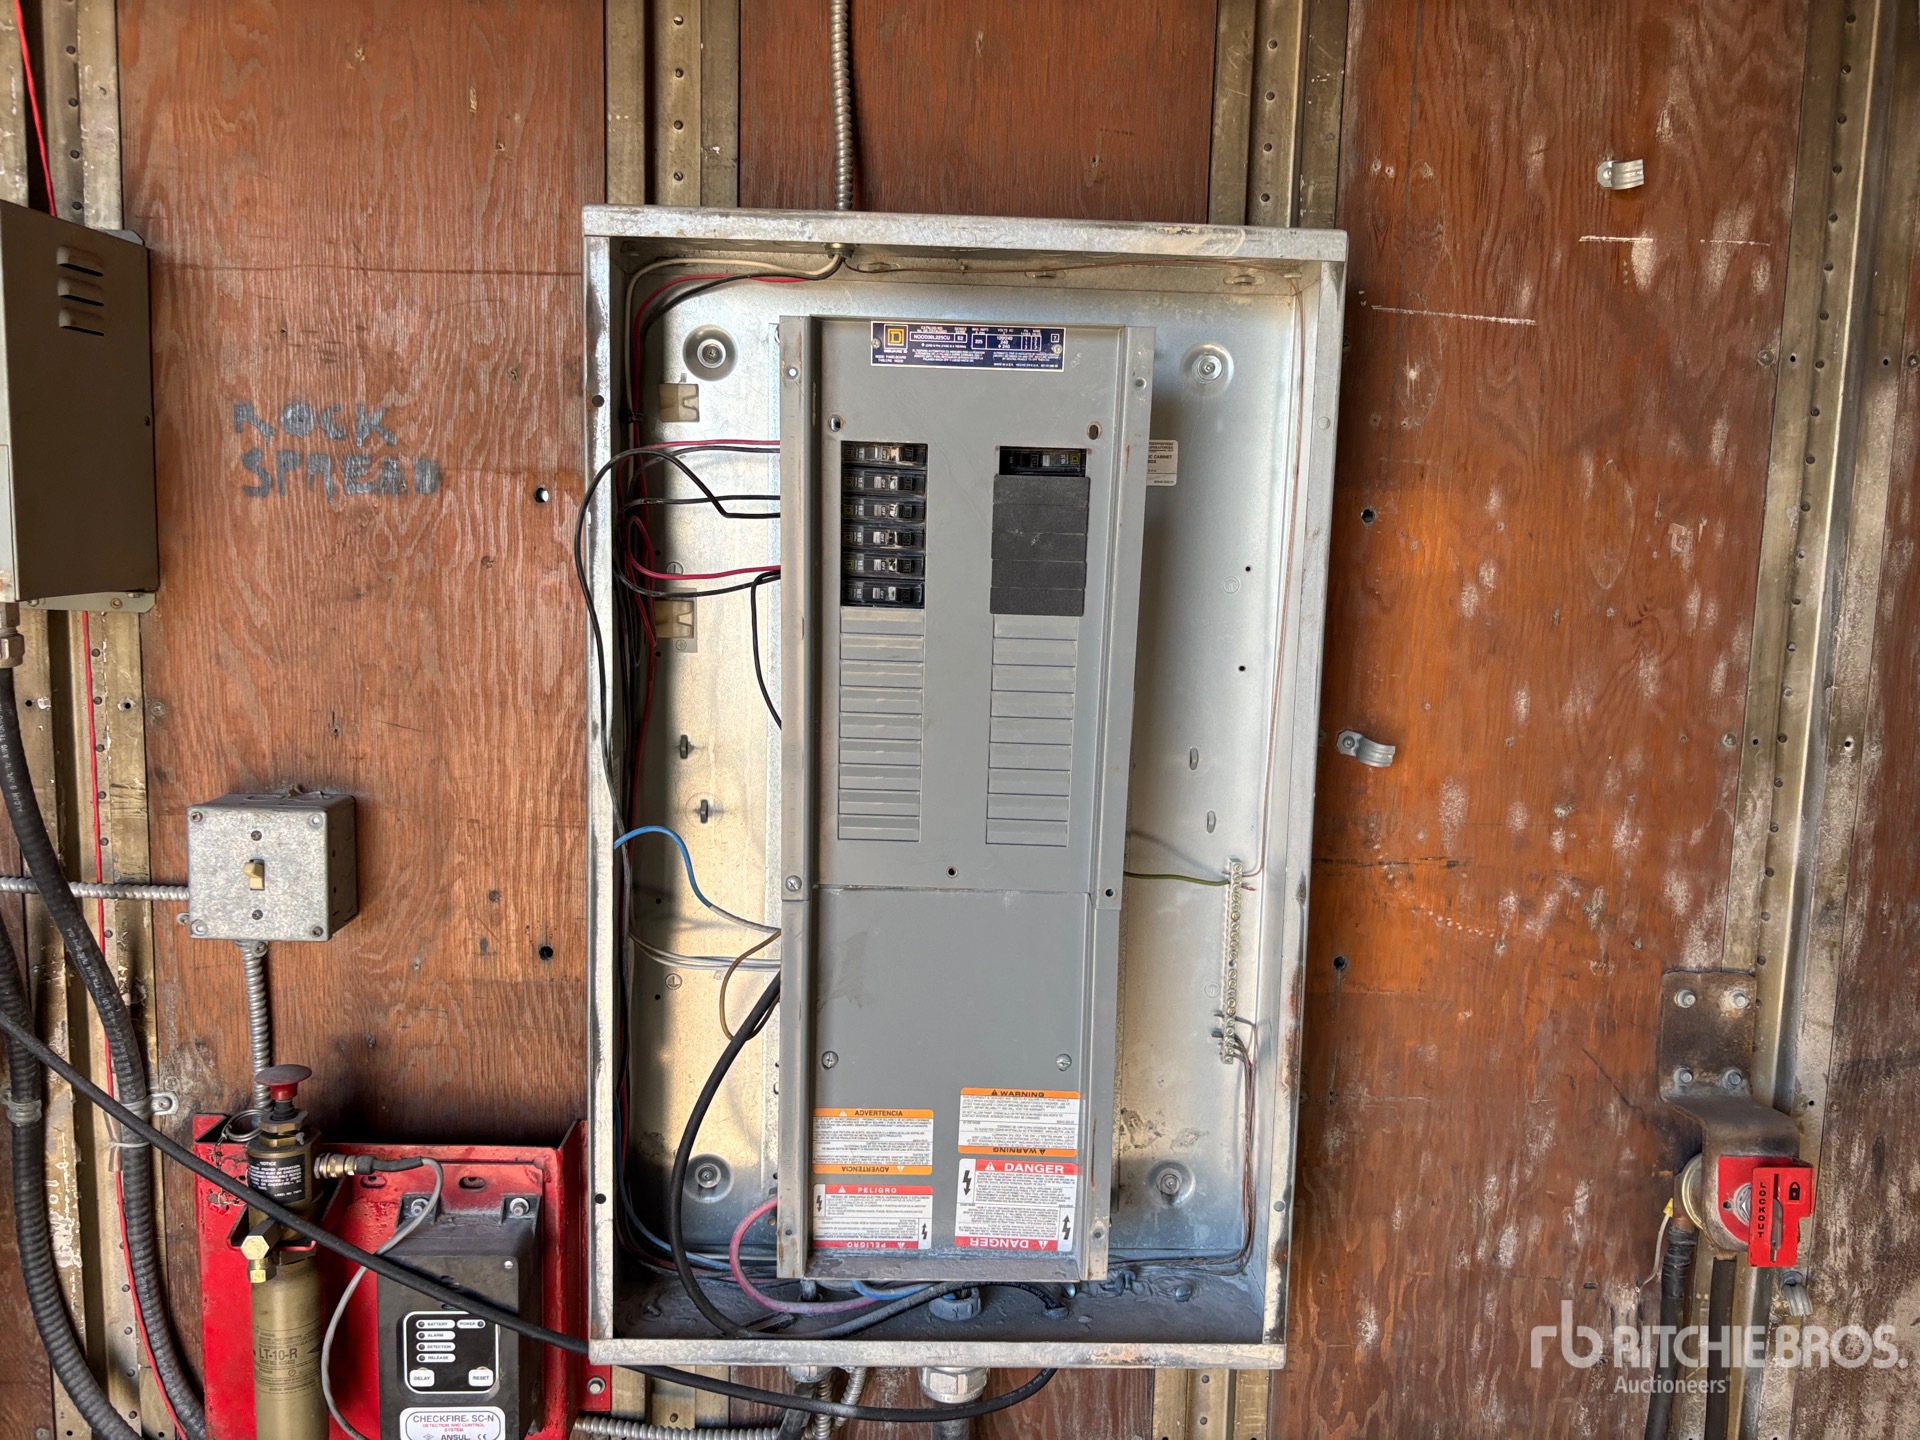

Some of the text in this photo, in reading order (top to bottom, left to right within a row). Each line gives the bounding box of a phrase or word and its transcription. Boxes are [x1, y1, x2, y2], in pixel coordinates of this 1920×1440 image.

[234, 402, 398, 448] ROCK
[241, 448, 441, 502] SPREAD
[1004, 1162, 1064, 1174] DANGER
[1758, 1182, 1766, 1238] LOCKOUT
[970, 1238, 1029, 1248] DANGER
[259, 1348, 298, 1360] LT-10-R
